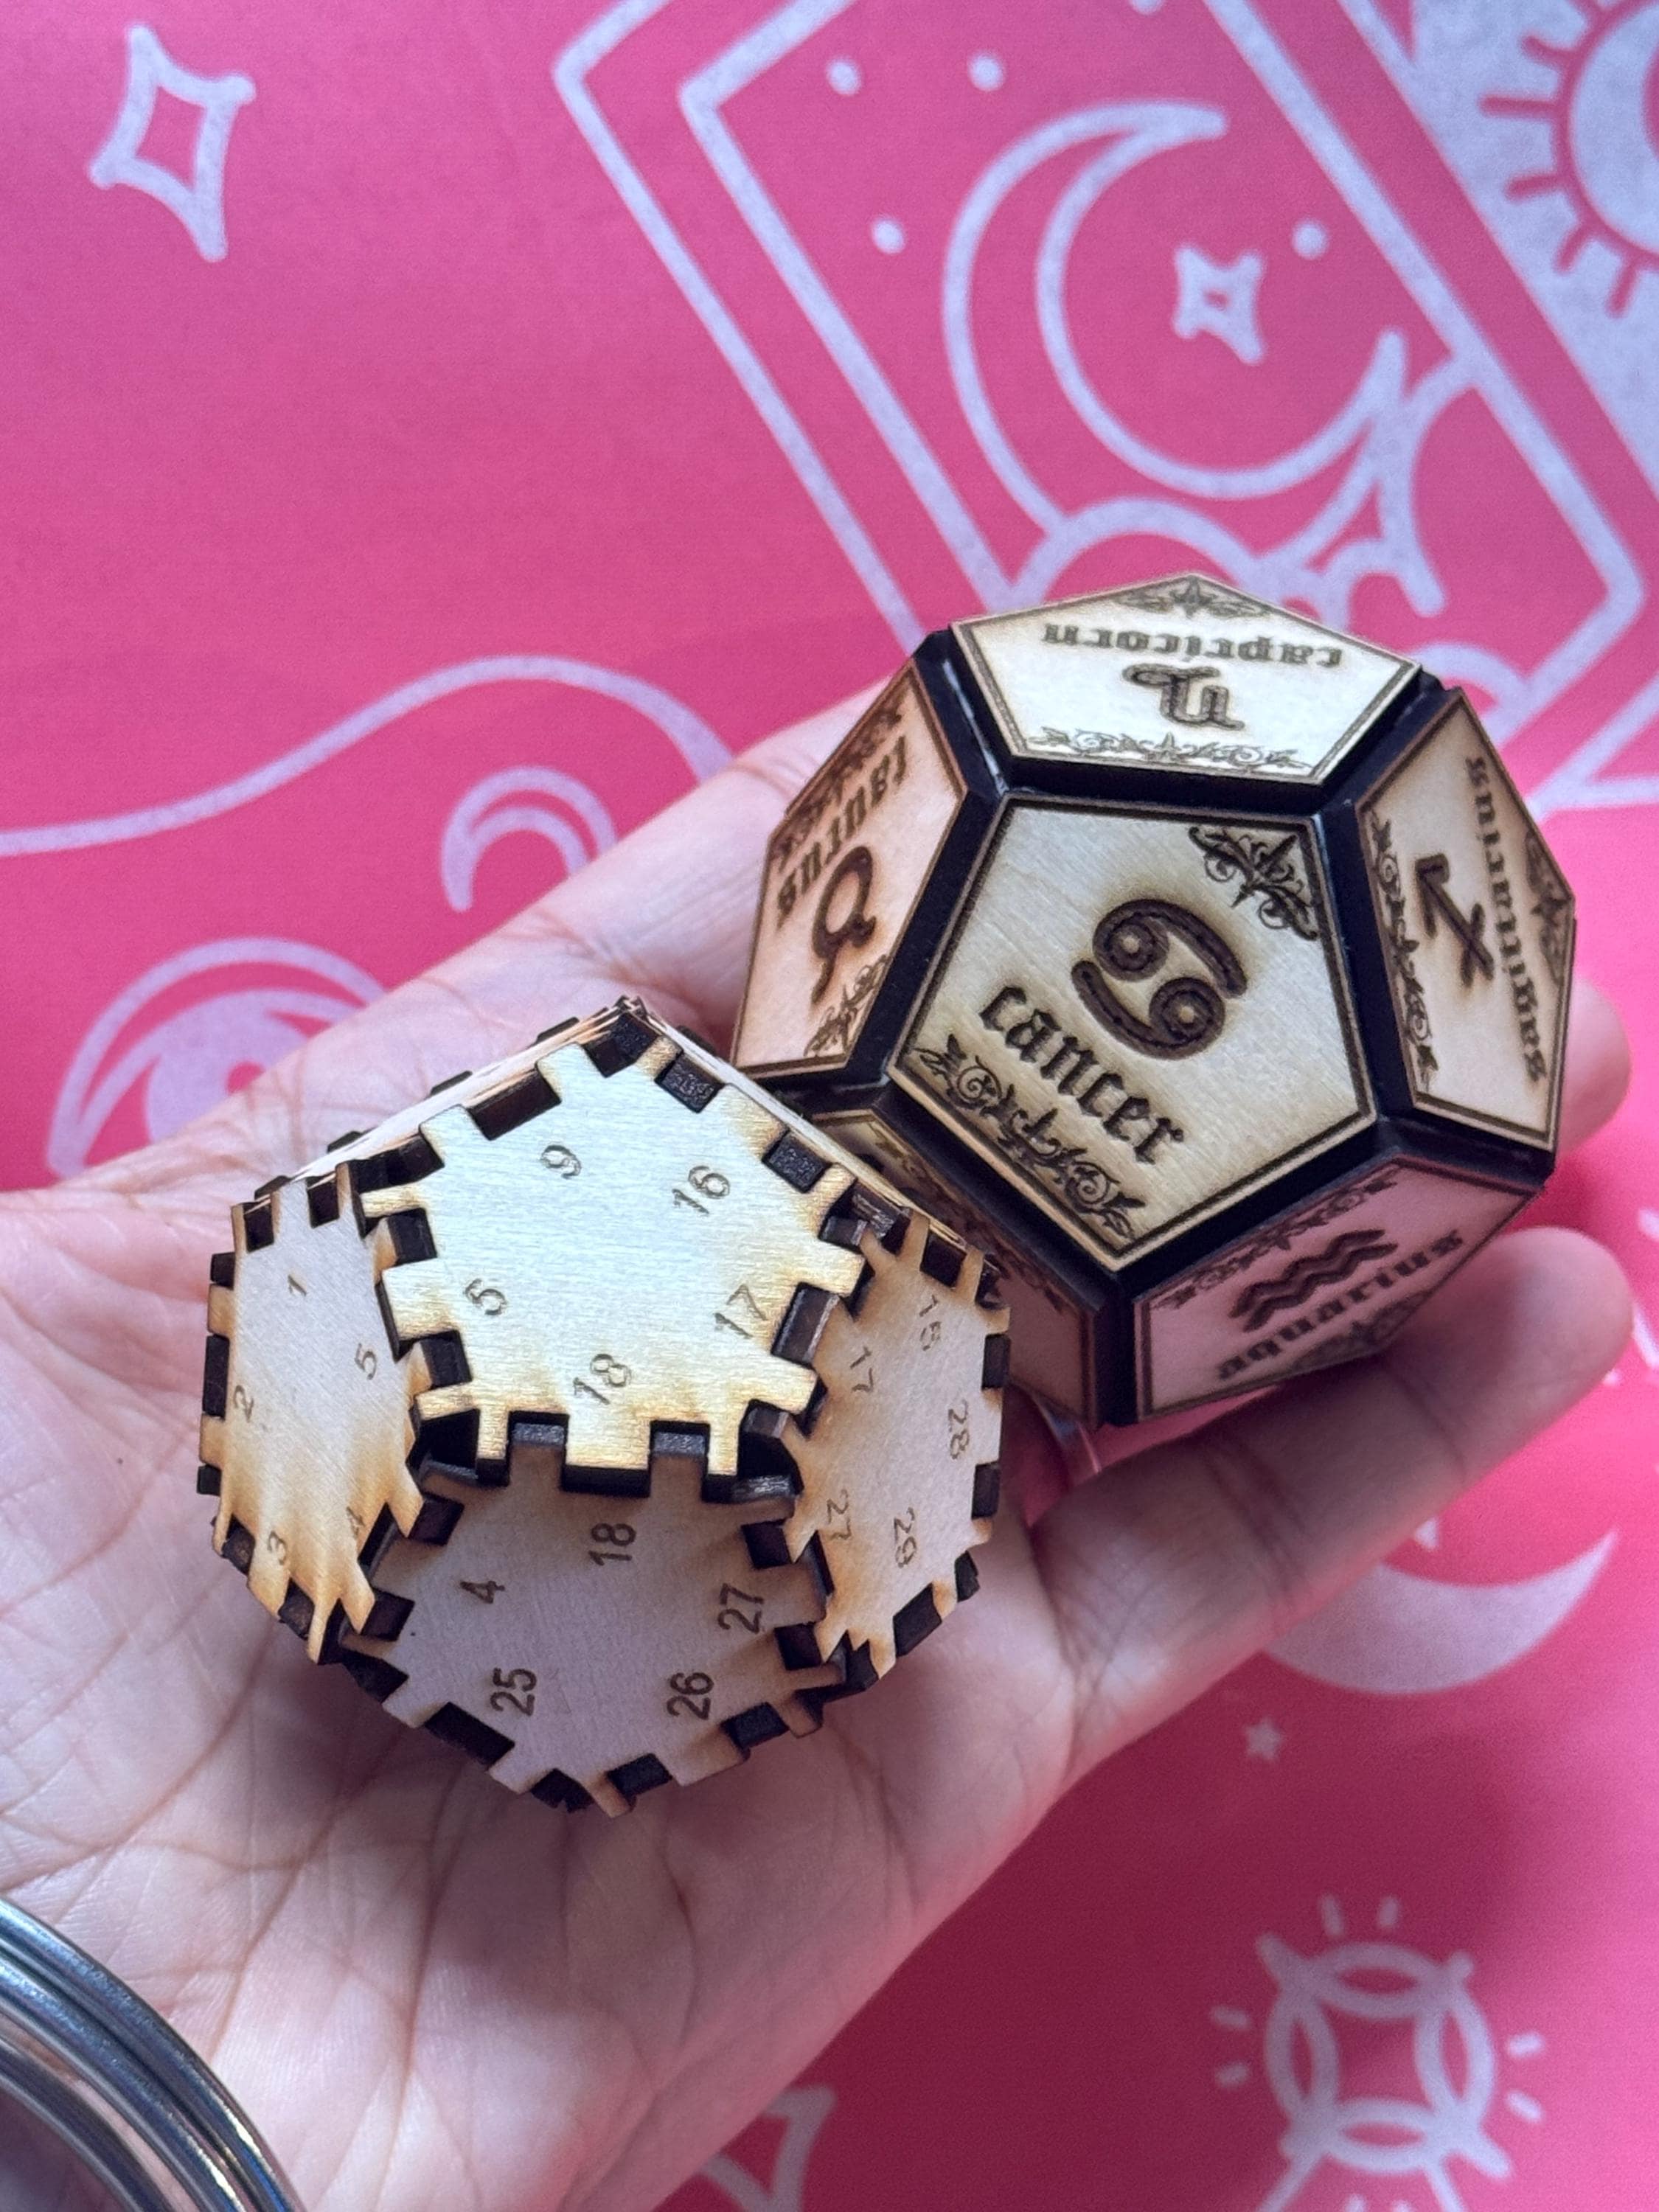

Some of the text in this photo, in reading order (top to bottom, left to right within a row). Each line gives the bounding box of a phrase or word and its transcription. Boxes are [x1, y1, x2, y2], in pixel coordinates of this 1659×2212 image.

[1042, 624, 1343, 667] capricorn
[776, 735, 909, 932] taurus
[1466, 757, 1547, 1084] sagittarius
[979, 986, 1185, 1165] cancer
[672, 1164, 731, 1215] 16
[288, 1273, 309, 1297] 1
[464, 1277, 507, 1316] 5
[1218, 1229, 1464, 1382] aquarius
[713, 1283, 768, 1339] 17
[355, 1342, 379, 1380] 5
[572, 1353, 632, 1405] 18
[849, 1345, 875, 1394] 17
[233, 1384, 255, 1423] 2
[947, 1399, 971, 1460] 28
[826, 1488, 852, 1542] 27
[893, 1506, 918, 1569] 29
[267, 1530, 287, 1565] 3
[588, 1522, 637, 1566] 18
[459, 1579, 506, 1604] 4
[717, 1582, 765, 1635] 27
[490, 1667, 538, 1717] 25
[667, 1671, 715, 1721] 26
